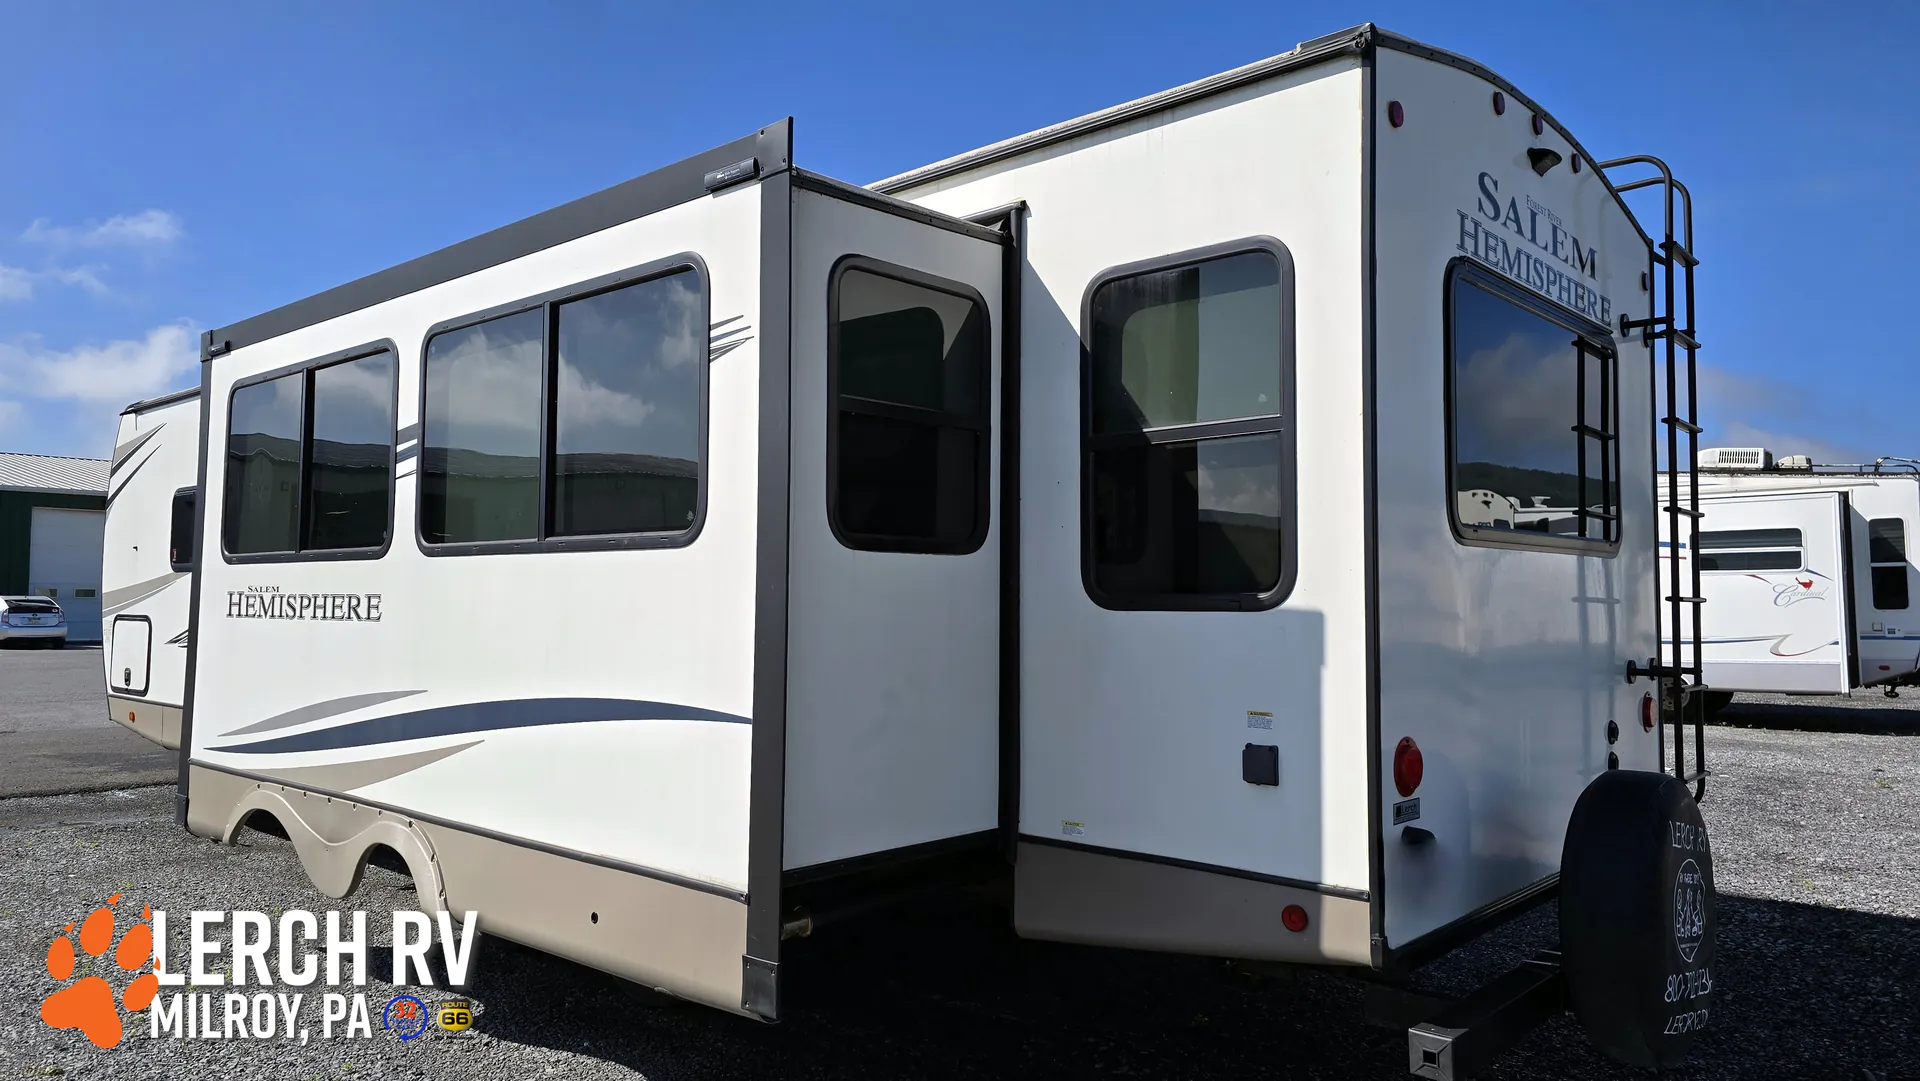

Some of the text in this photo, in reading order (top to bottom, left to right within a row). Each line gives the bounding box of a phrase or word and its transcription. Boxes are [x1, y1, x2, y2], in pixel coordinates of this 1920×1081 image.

[1478, 172, 1598, 281] SALEM
[1526, 194, 1563, 228] FOREST RIVER
[1456, 208, 1612, 327] HEMISPHERE
[248, 585, 280, 593] SALEM
[1773, 584, 1829, 606] Cardinal
[226, 591, 383, 622] HEMISPHERE
